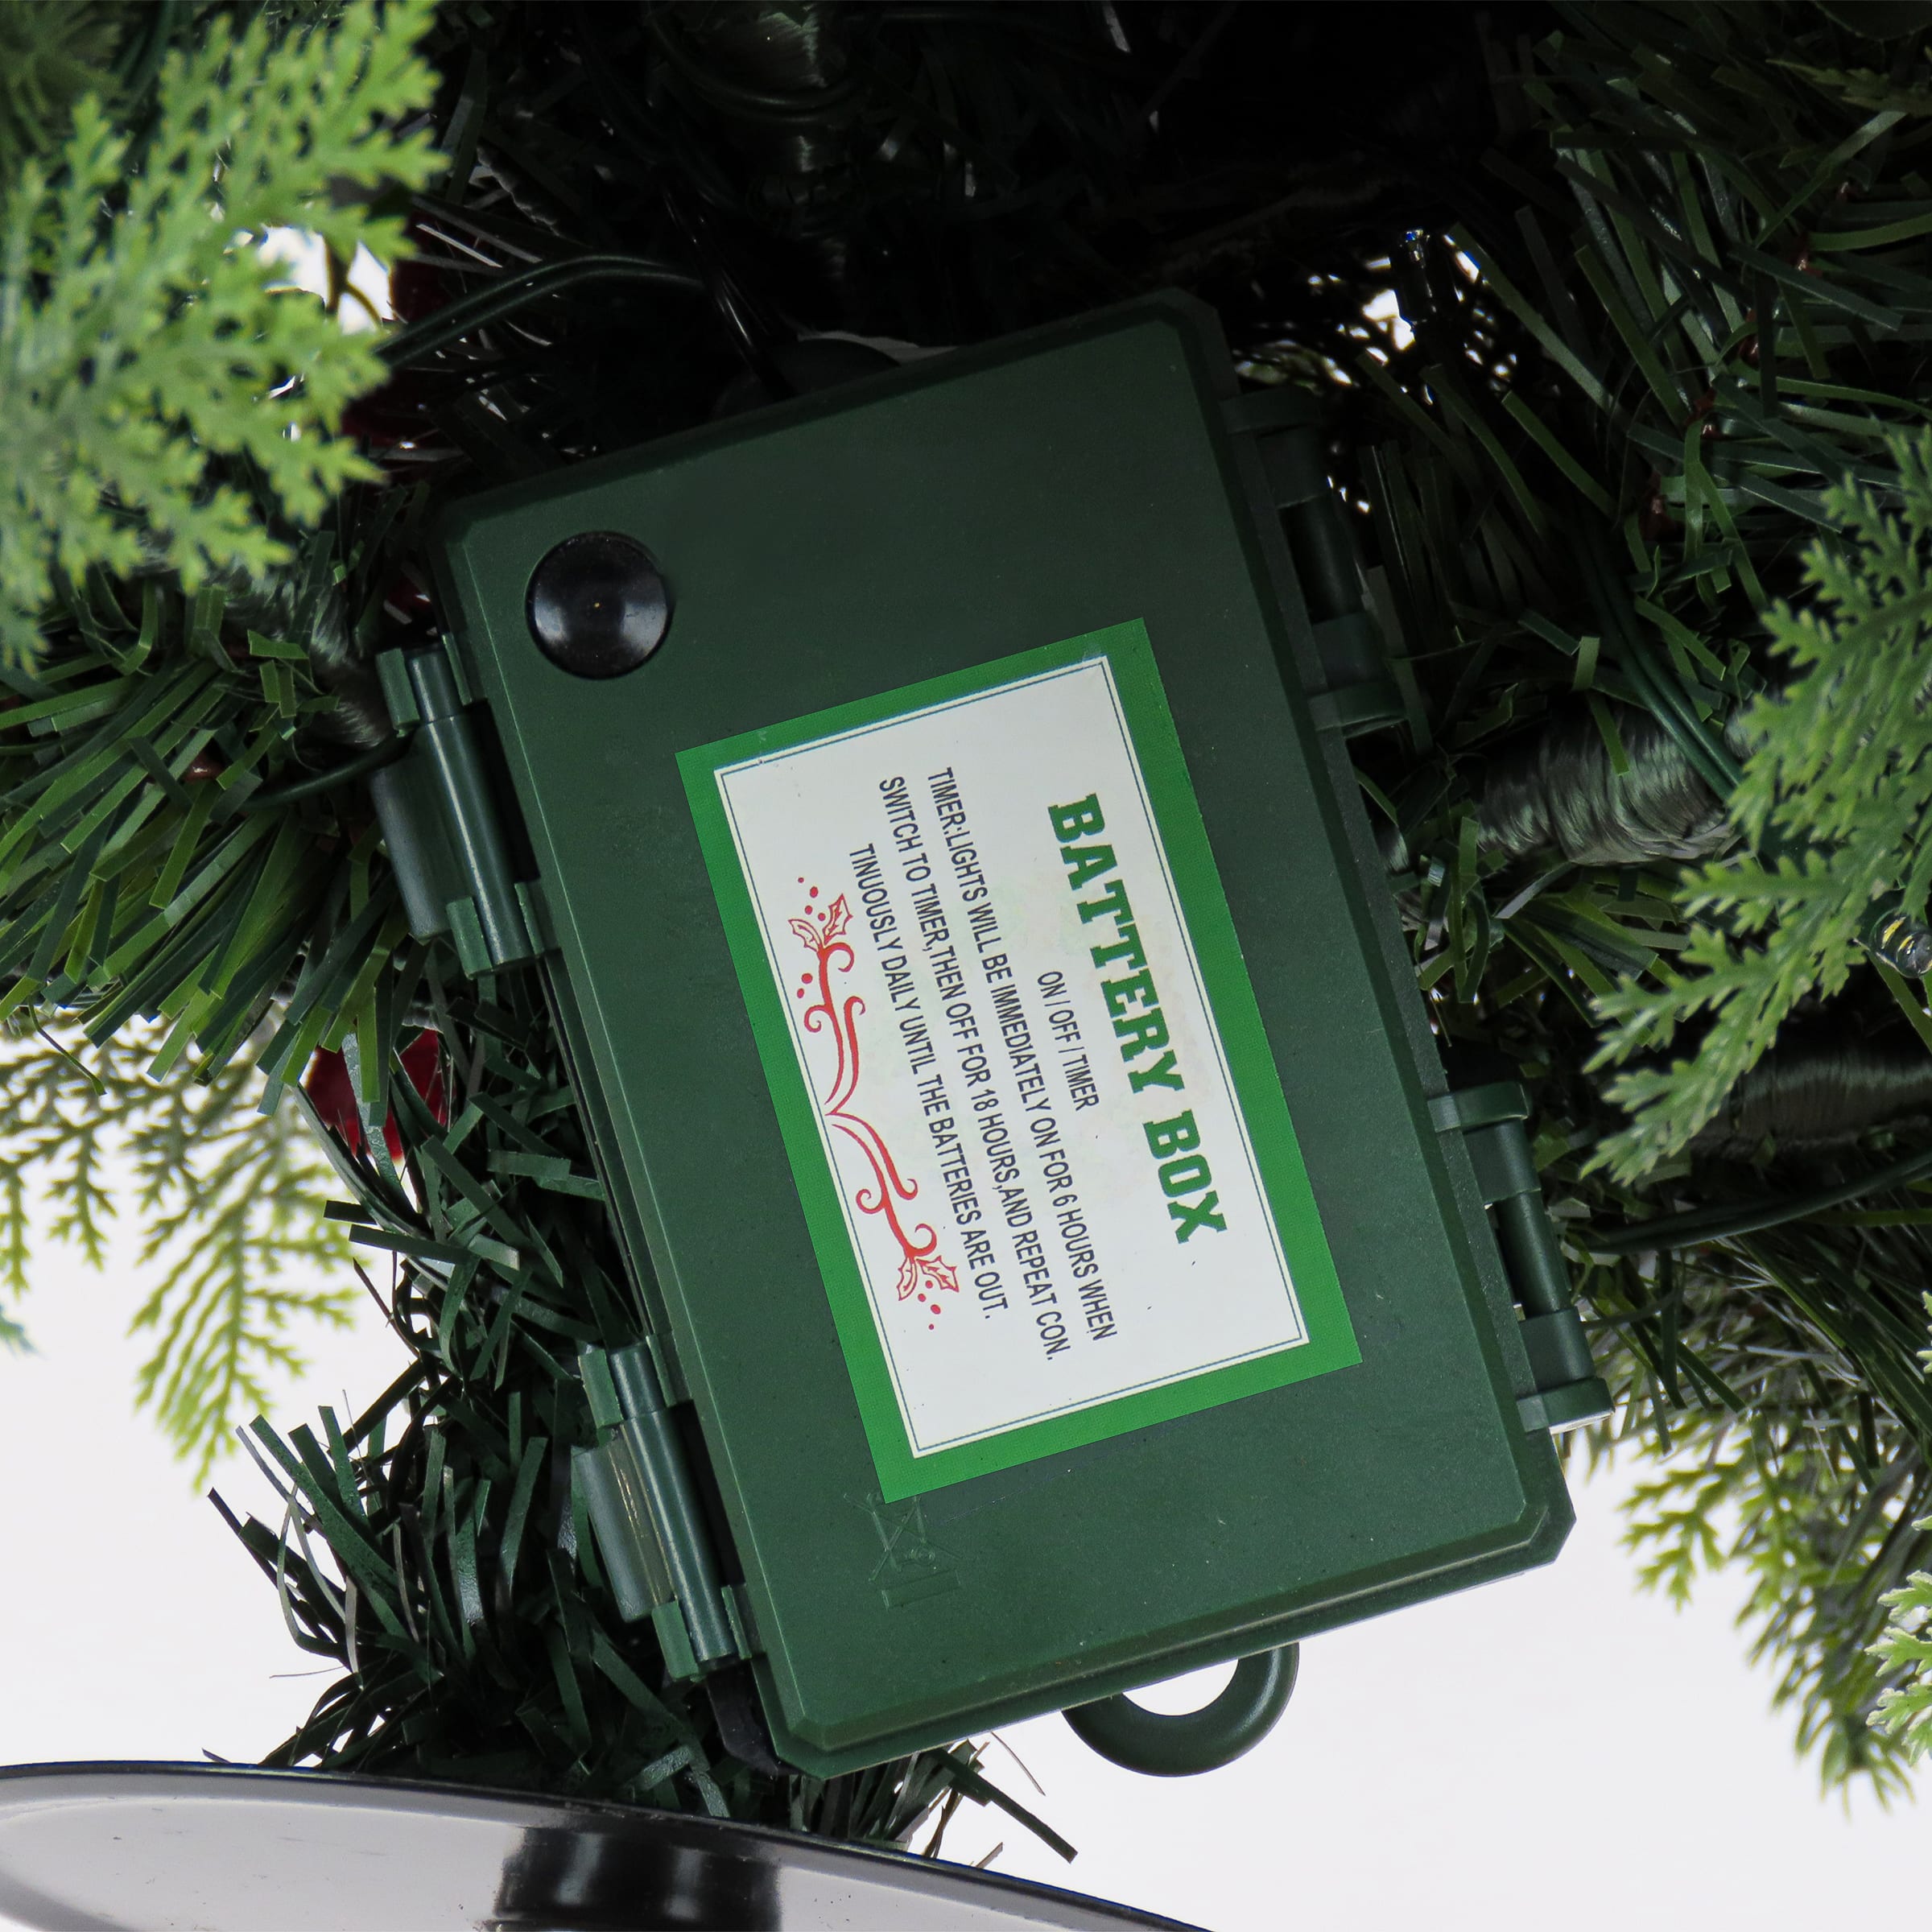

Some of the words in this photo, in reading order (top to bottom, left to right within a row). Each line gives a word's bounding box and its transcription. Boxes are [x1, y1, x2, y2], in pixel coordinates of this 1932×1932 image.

[878, 776, 923, 852] SWITCH
[927, 766, 988, 902] TIMER:LIGHTS
[902, 852, 931, 882] TO
[848, 842, 903, 951] TINUOUSLY
[910, 882, 967, 1001] TIMER,THEN
[966, 902, 1001, 953] WILL
[881, 954, 921, 1011] DAILY
[980, 952, 1013, 984] BE
[1036, 971, 1067, 999] ON
[945, 1002, 979, 1039] OFF
[1046, 792, 1185, 1094] BATTERY
[1141, 1108, 1228, 1244] BOX
[1048, 1009, 1081, 1042] OFF
[898, 1014, 936, 1075] UNTIL
[956, 1042, 991, 1088] FOR
[989, 983, 1051, 1112] IMMEDIATELY
[916, 1073, 951, 1117] THE
[970, 1088, 999, 1112] 18
[1062, 1053, 1099, 1111] TIMER
[1030, 1117, 1061, 1148] ON
[928, 1117, 981, 1225] BATTERIES
[976, 1113, 1033, 1228] HOURS,AND
[1038, 1148, 1073, 1193] FOR
[1051, 1193, 1078, 1207] 6
[960, 1229, 995, 1269] ARE
[1011, 1229, 1057, 1306] REPEAT
[1056, 1208, 1099, 1278] HOURS
[973, 1271, 1008, 1319] OUT.
[1077, 1278, 1117, 1340] WHEN
[1035, 1311, 1071, 1360] CON.
